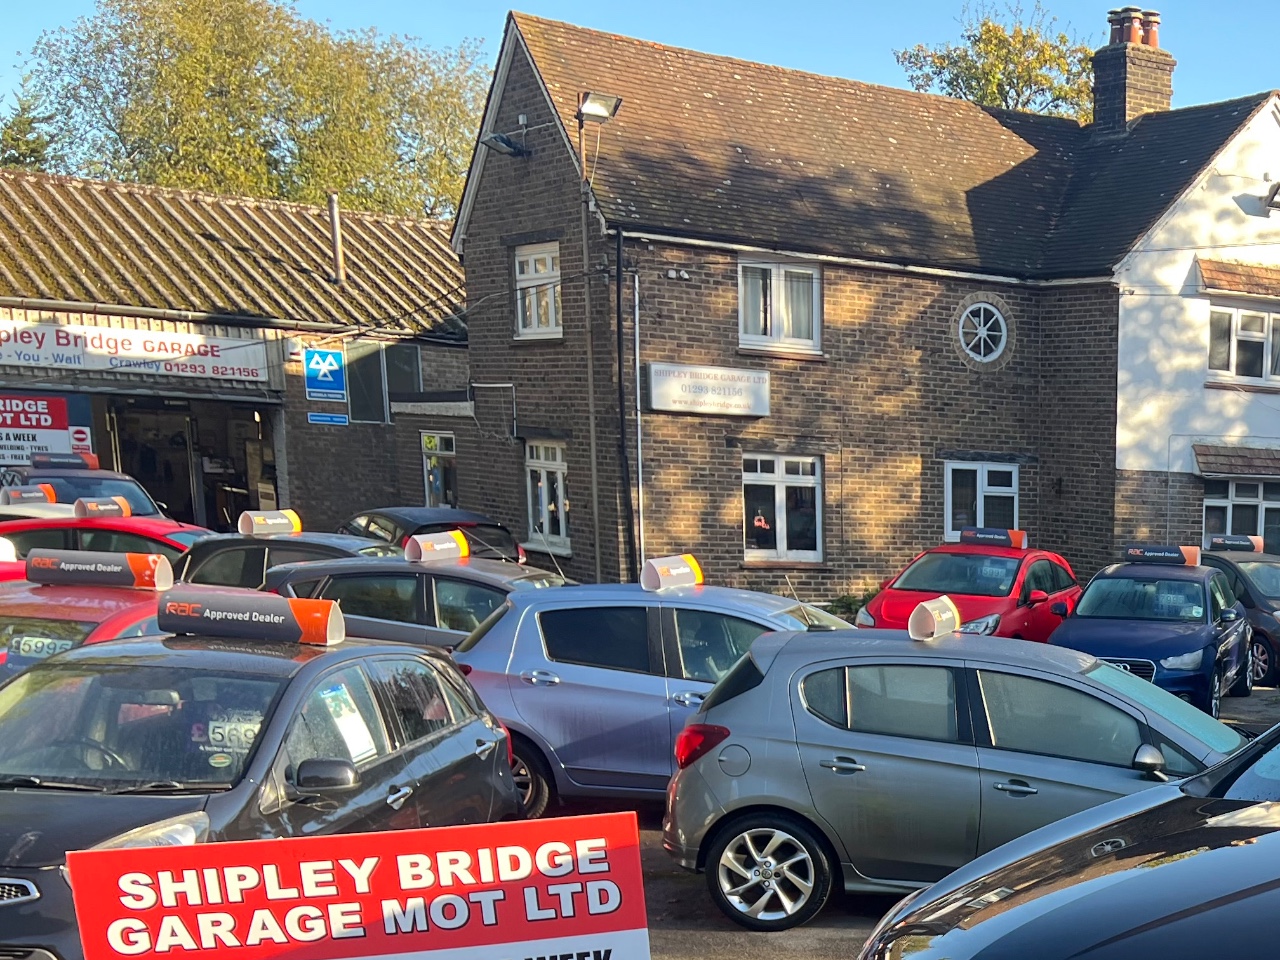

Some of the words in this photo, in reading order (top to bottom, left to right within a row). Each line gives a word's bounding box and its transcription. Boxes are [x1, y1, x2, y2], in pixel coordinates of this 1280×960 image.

[55, 328, 132, 355] Bridge
[143, 340, 220, 357] GARAGE
[14, 350, 40, 362] You
[52, 353, 82, 365] Wait
[109, 357, 160, 371] Crawley
[164, 363, 207, 374] 01293
[212, 366, 259, 377] 821156
[654, 369, 688, 378] SHIPLEY
[690, 371, 719, 380] BRIDGE
[720, 373, 751, 383] GARAGE
[753, 376, 767, 384] LTD
[681, 384, 709, 394] 01293
[711, 386, 743, 396] 821156
[0, 413, 14, 425] T
[20, 413, 52, 426] LTD
[13, 433, 37, 442] WEEK
[60, 561, 95, 572] Approved
[96, 563, 122, 572] Dealer
[203, 608, 250, 621] Approved
[252, 612, 285, 623] Dealer
[117, 857, 379, 911] SHIPLEY
[396, 837, 610, 891] BRIDGE
[106, 902, 366, 956] GARAGE
[380, 889, 505, 935] MOT
[523, 879, 622, 922] LTD
